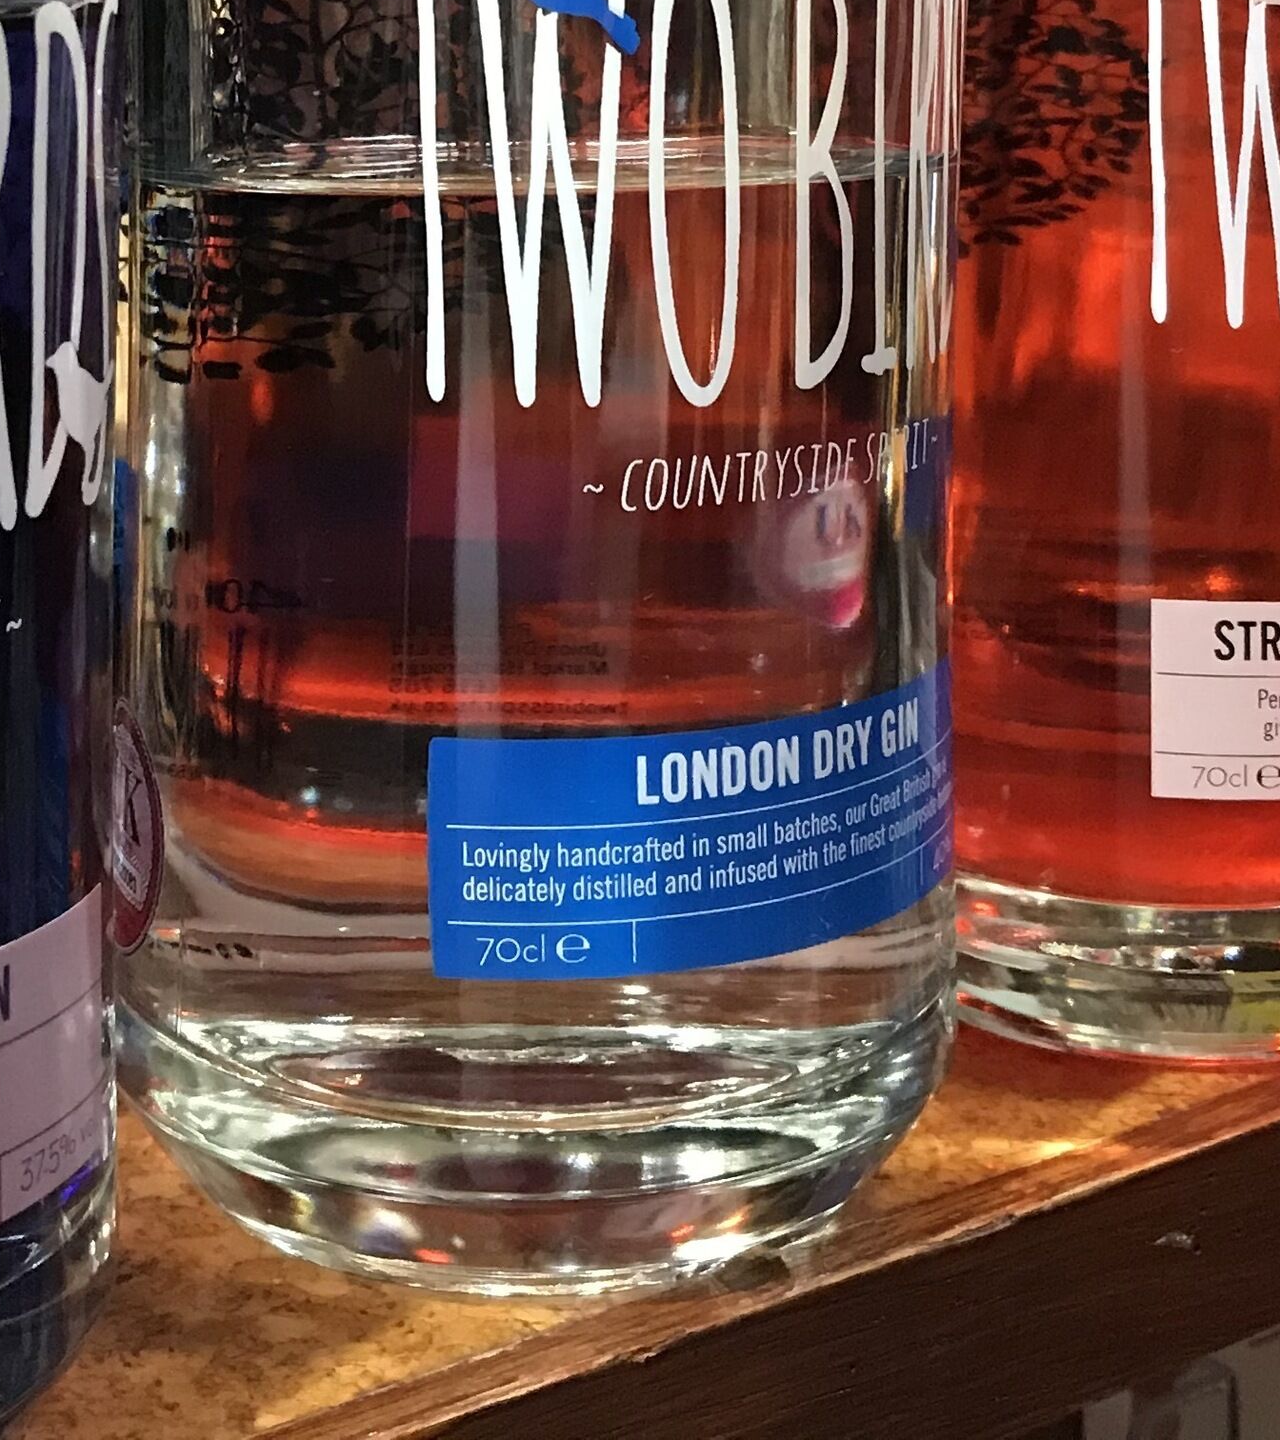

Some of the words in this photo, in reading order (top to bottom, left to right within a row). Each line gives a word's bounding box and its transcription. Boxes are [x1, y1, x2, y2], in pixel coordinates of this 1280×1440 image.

[620, 437, 857, 512] COUNTRYSIDE
[636, 734, 801, 806] LONDON
[812, 714, 873, 781] DRY
[880, 696, 919, 758] GIN
[1192, 765, 1248, 790] 70cl
[462, 841, 550, 873] Lovingly
[556, 833, 686, 868] handcrafted
[692, 831, 710, 858] in
[717, 822, 768, 856] small
[773, 812, 842, 846] batches,
[845, 803, 868, 827] our
[869, 785, 901, 817] Great
[462, 875, 567, 907] delicately
[572, 871, 658, 902] distilled
[664, 867, 702, 893] and
[709, 855, 778, 890] infused
[783, 845, 819, 876] with
[822, 837, 848, 864] the
[850, 824, 887, 858] finest
[475, 933, 547, 967] 70cl
